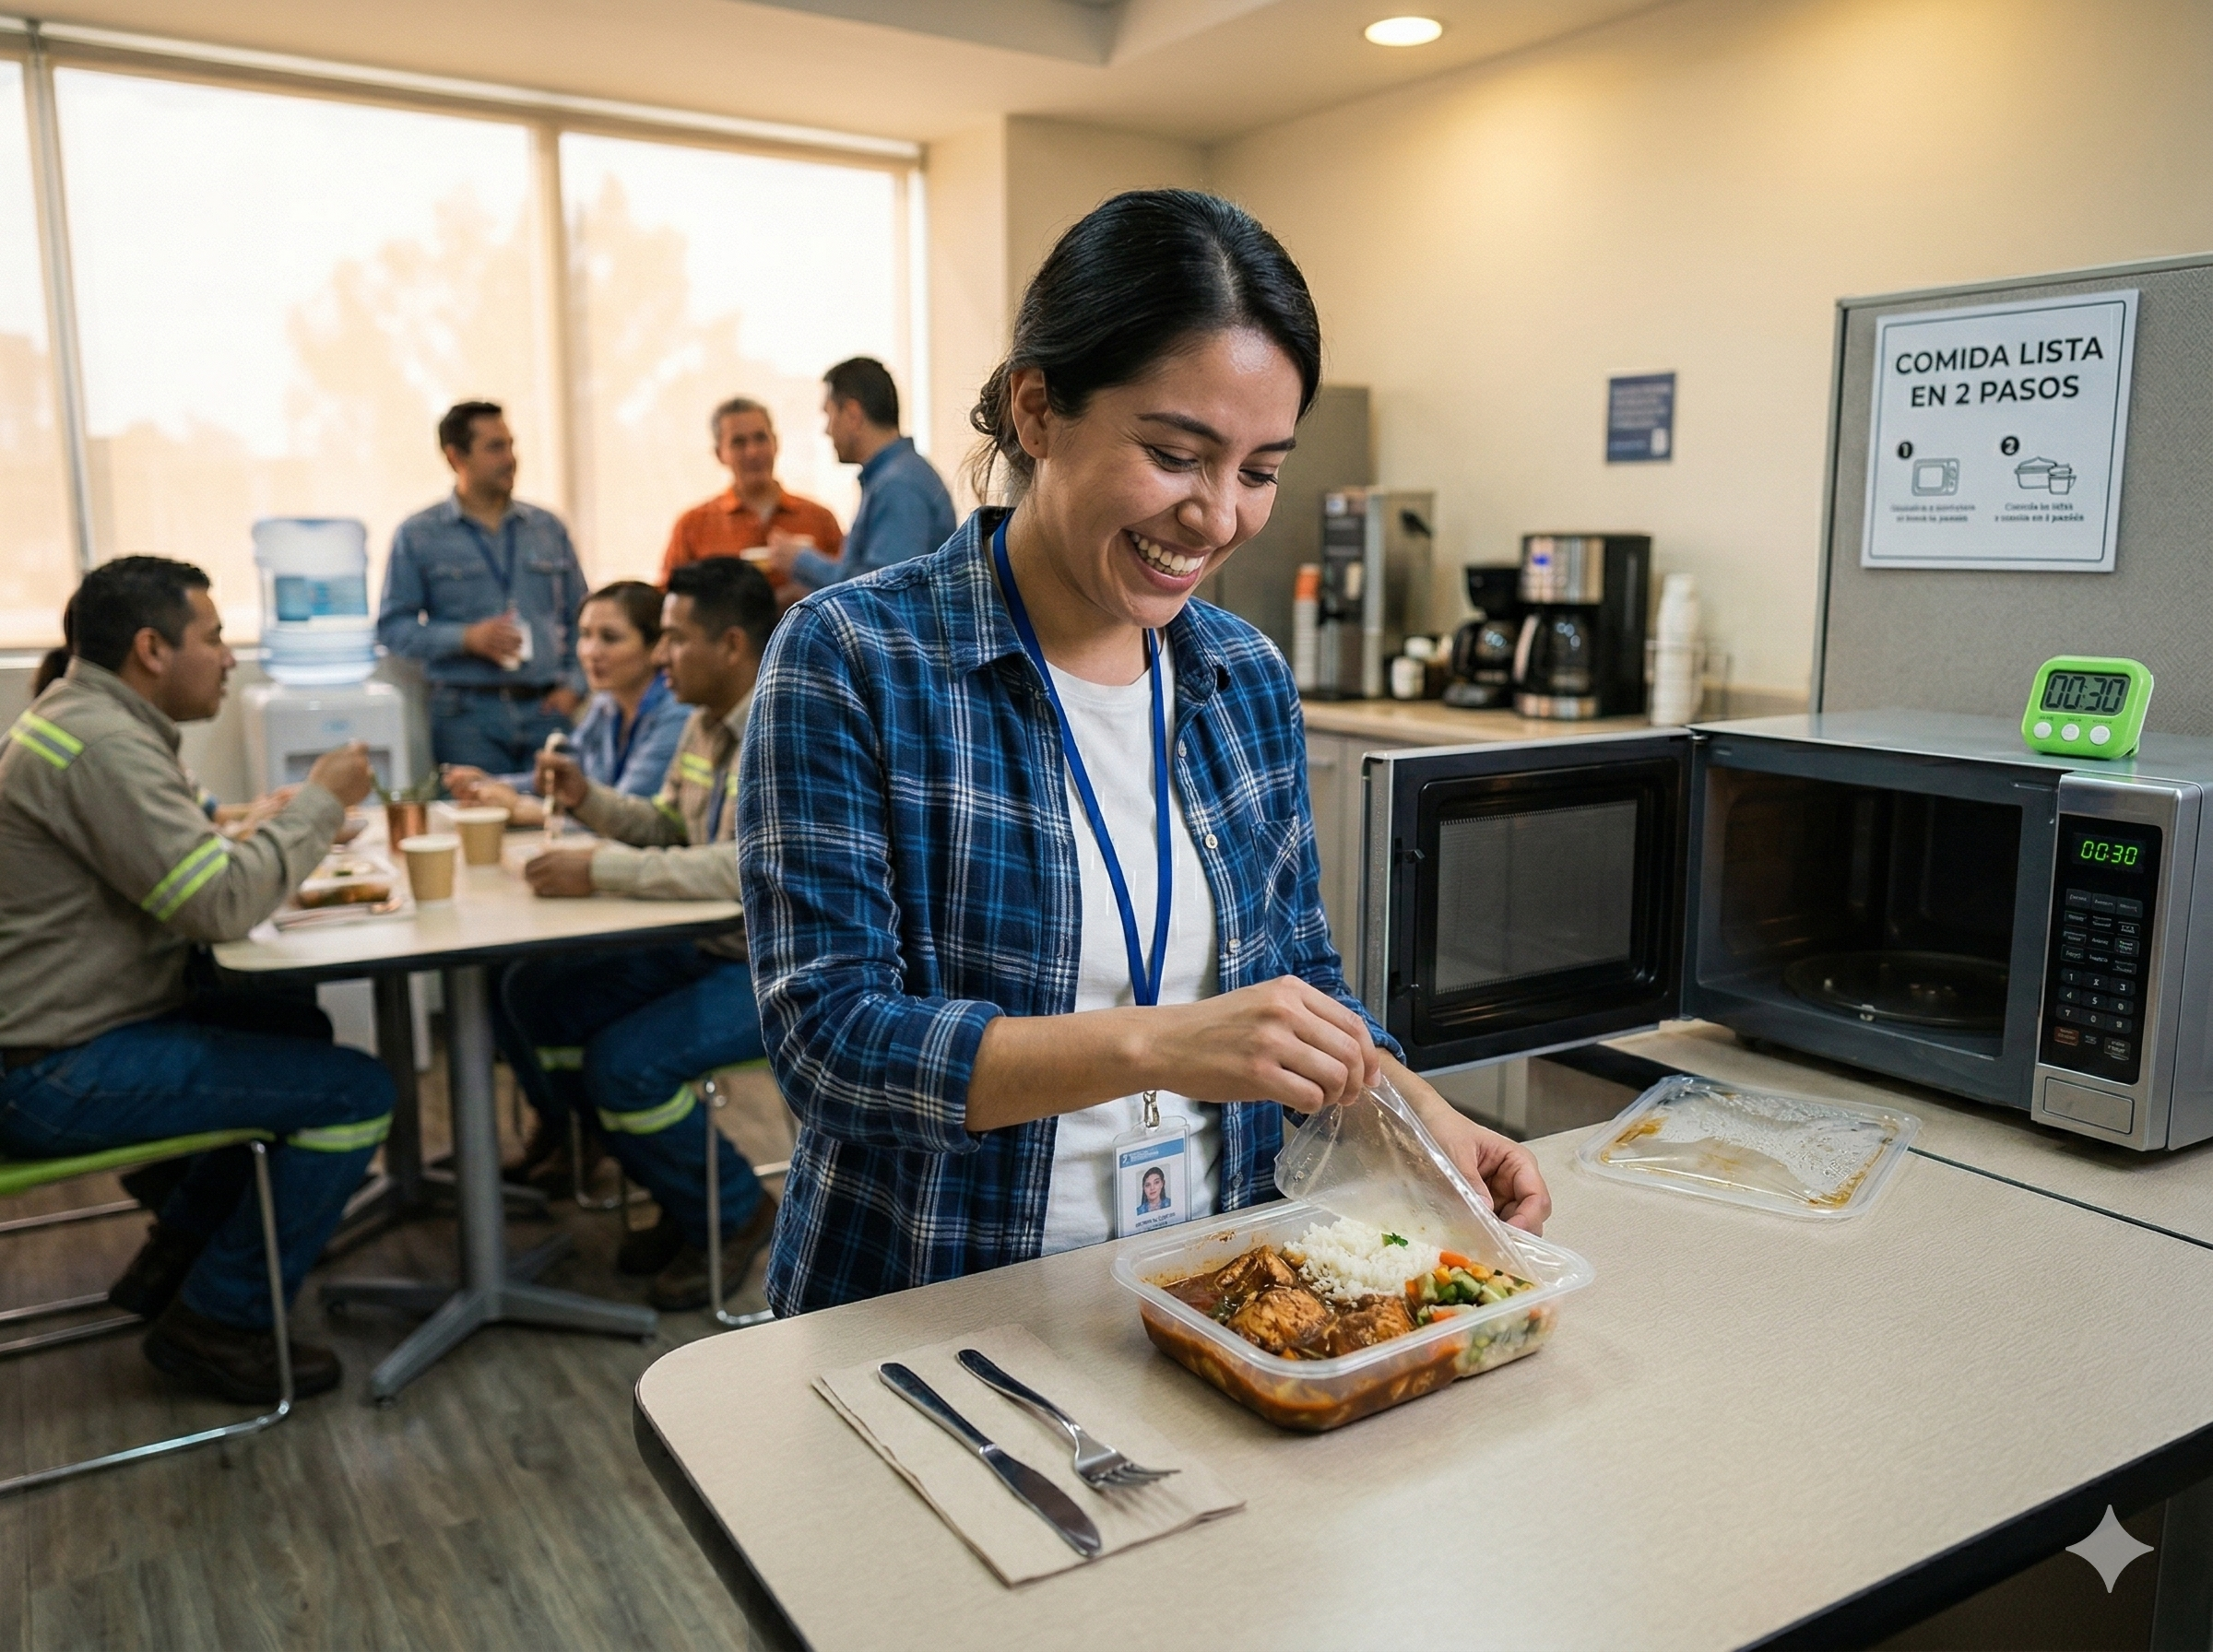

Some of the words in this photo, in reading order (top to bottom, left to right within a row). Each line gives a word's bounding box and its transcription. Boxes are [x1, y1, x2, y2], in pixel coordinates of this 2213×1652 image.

[1896, 345, 2009, 375] COMIDA
[2020, 336, 2103, 365] LISTA
[1911, 384, 1947, 407] EN
[1954, 383, 1970, 405] 2
[1980, 375, 2079, 404] PASOS
[2045, 675, 2125, 713] 00:30
[2065, 1009, 2071, 1017] 7
[2091, 997, 2098, 1005] 5
